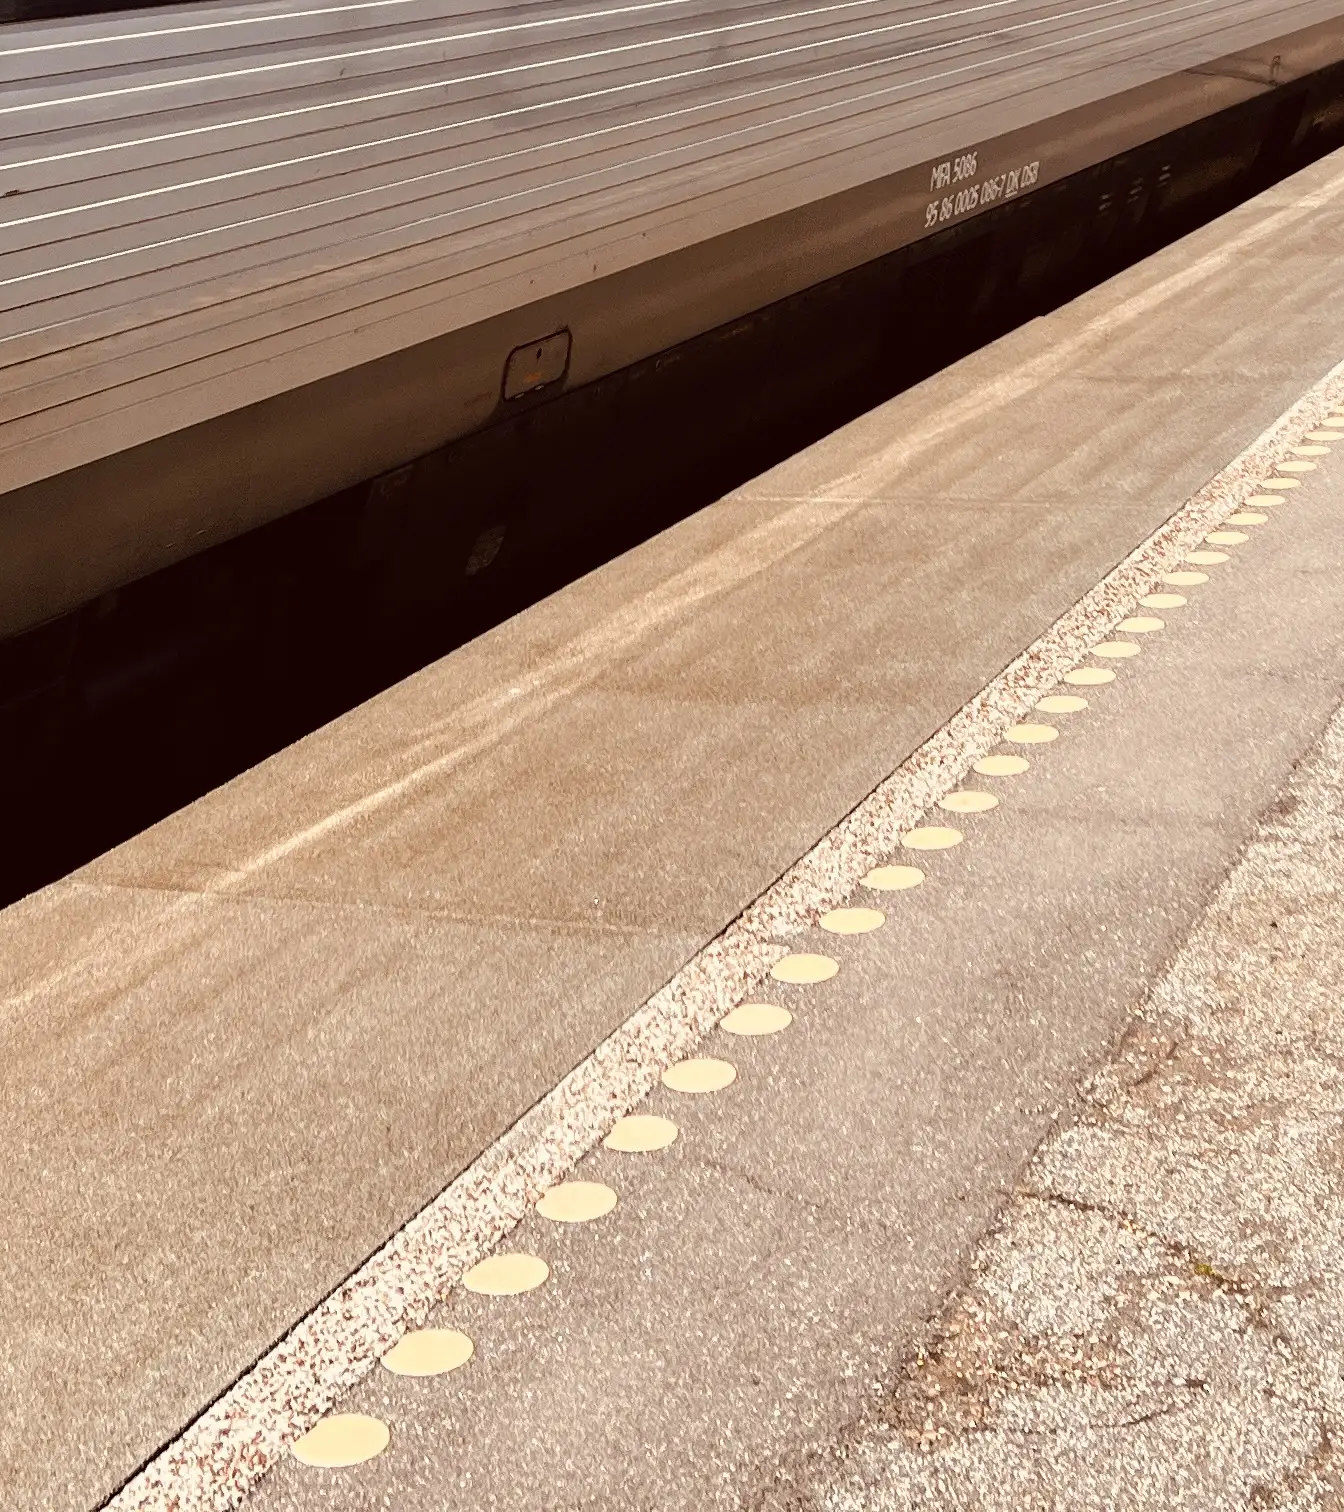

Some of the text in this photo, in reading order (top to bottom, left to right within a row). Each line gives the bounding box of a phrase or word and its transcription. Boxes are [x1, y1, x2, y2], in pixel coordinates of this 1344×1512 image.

[930, 161, 951, 192] MFA
[924, 200, 939, 228] 95
[939, 194, 955, 222] 86
